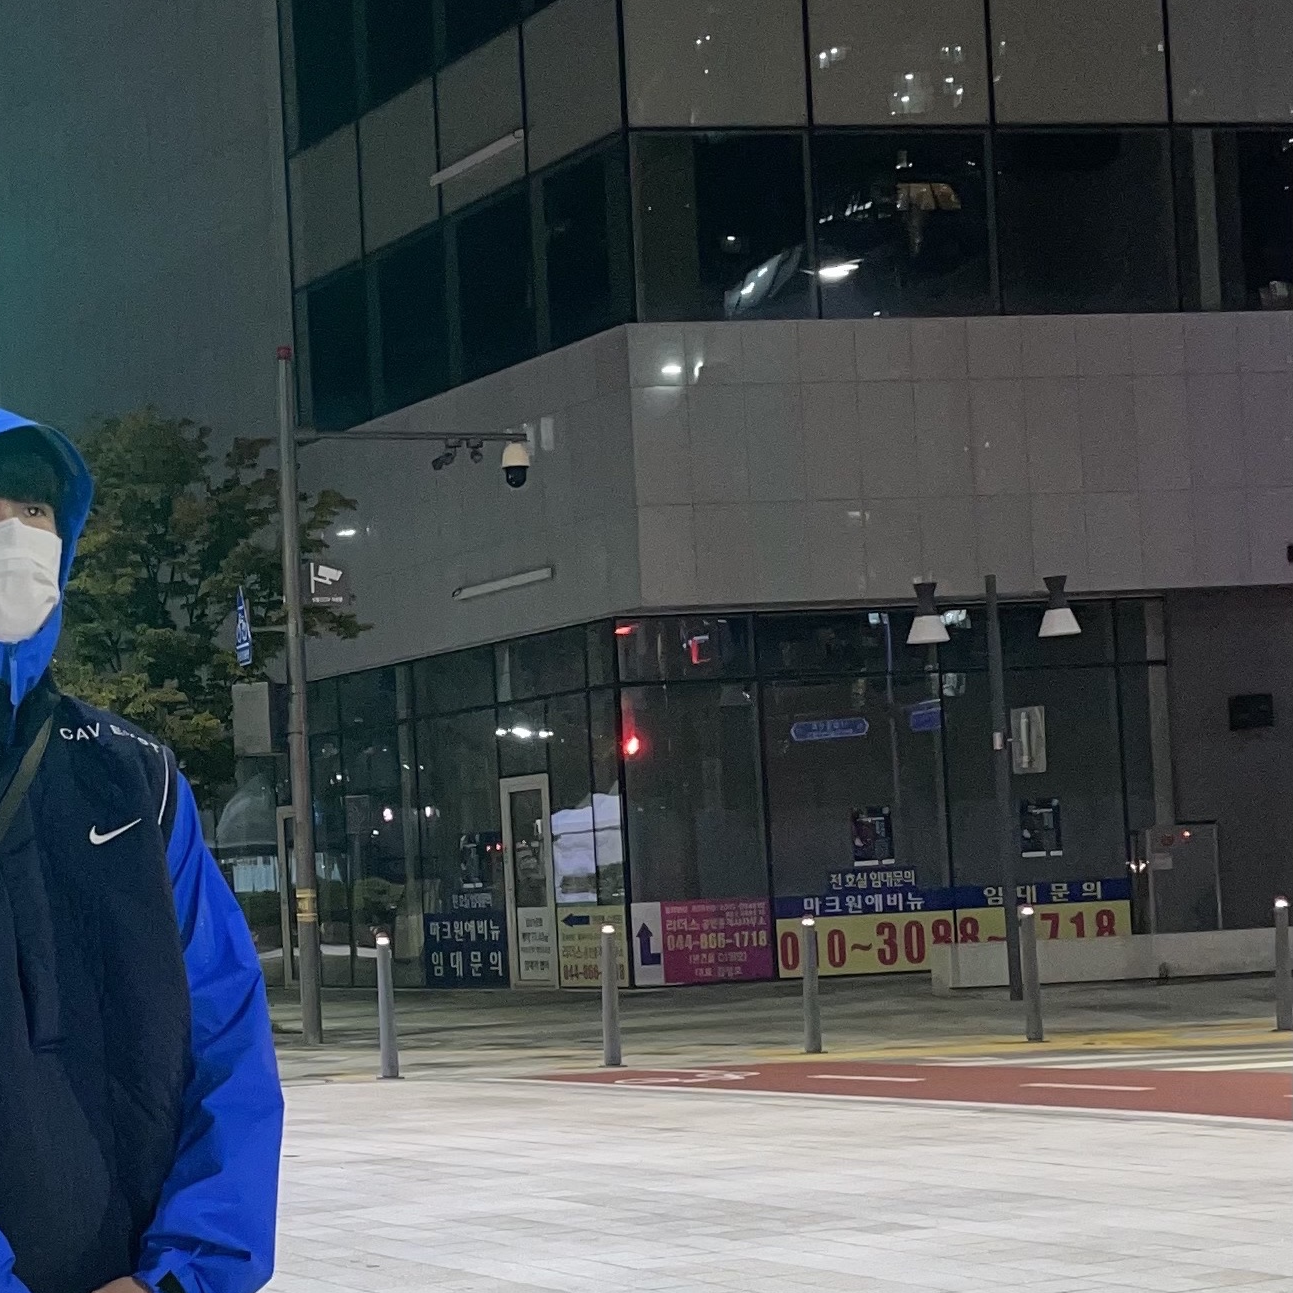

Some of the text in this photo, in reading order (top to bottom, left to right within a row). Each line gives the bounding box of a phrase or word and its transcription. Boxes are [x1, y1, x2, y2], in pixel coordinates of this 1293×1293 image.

[59, 722, 100, 741] CAV
[869, 869, 916, 888] 임대문의
[803, 892, 926, 915] 마크원에비뉴
[429, 919, 501, 943] 마크원에비뉴
[431, 950, 503, 977] 임대문의
